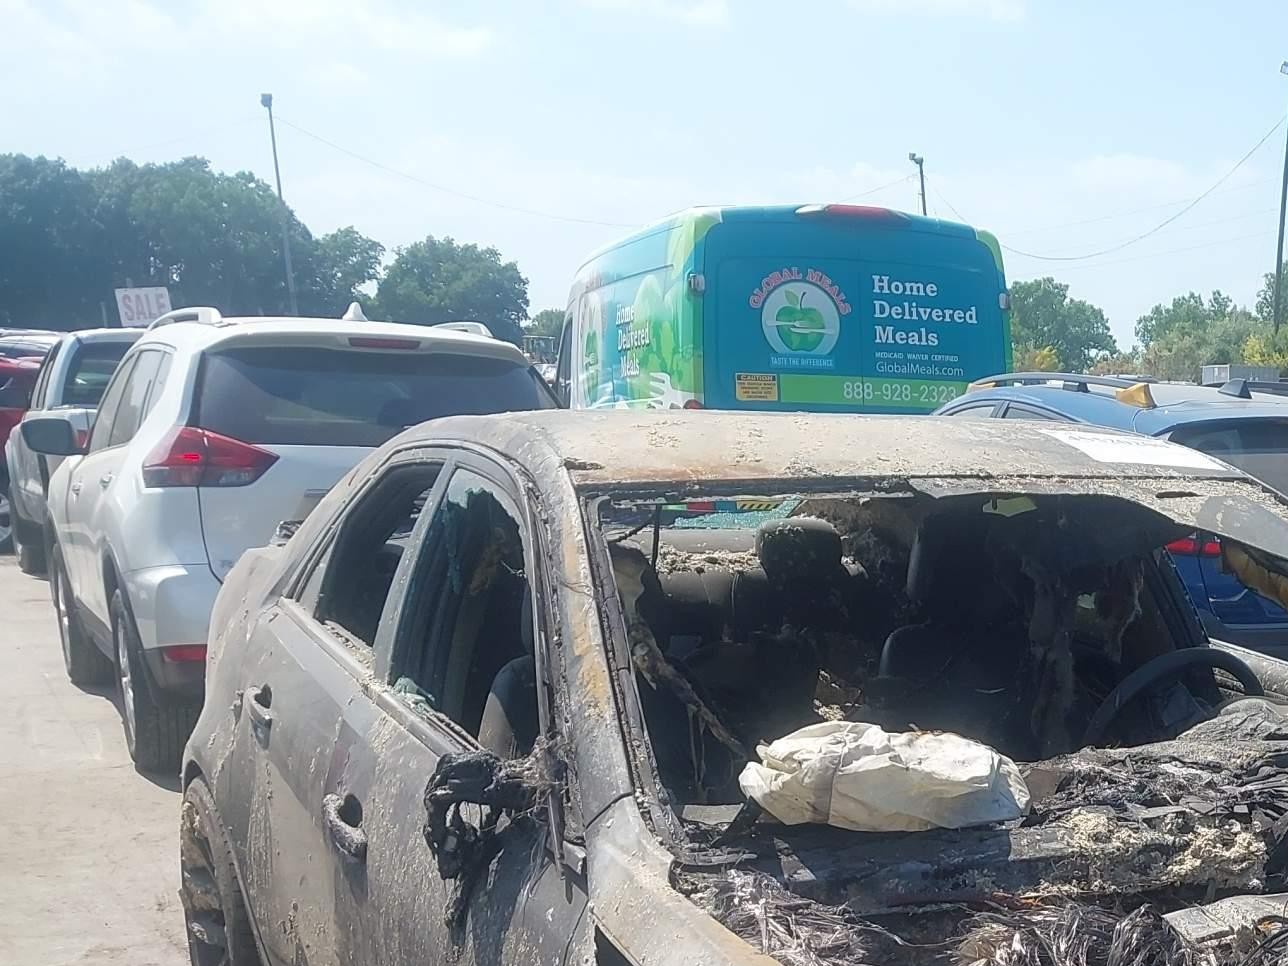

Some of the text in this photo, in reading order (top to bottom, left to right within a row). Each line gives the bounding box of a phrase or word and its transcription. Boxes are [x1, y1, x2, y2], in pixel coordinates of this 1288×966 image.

[749, 266, 852, 315] GLOBAL MEALS
[872, 274, 938, 297] Home
[122, 293, 166, 321] SALE
[615, 303, 635, 325] Home
[873, 300, 978, 324] Delivered
[618, 320, 650, 352] Delivered
[874, 325, 939, 346] Meals
[620, 353, 640, 377] Meals
[876, 361, 964, 377] GlobalMeals.com
[843, 382, 957, 402] 888-928-2323
